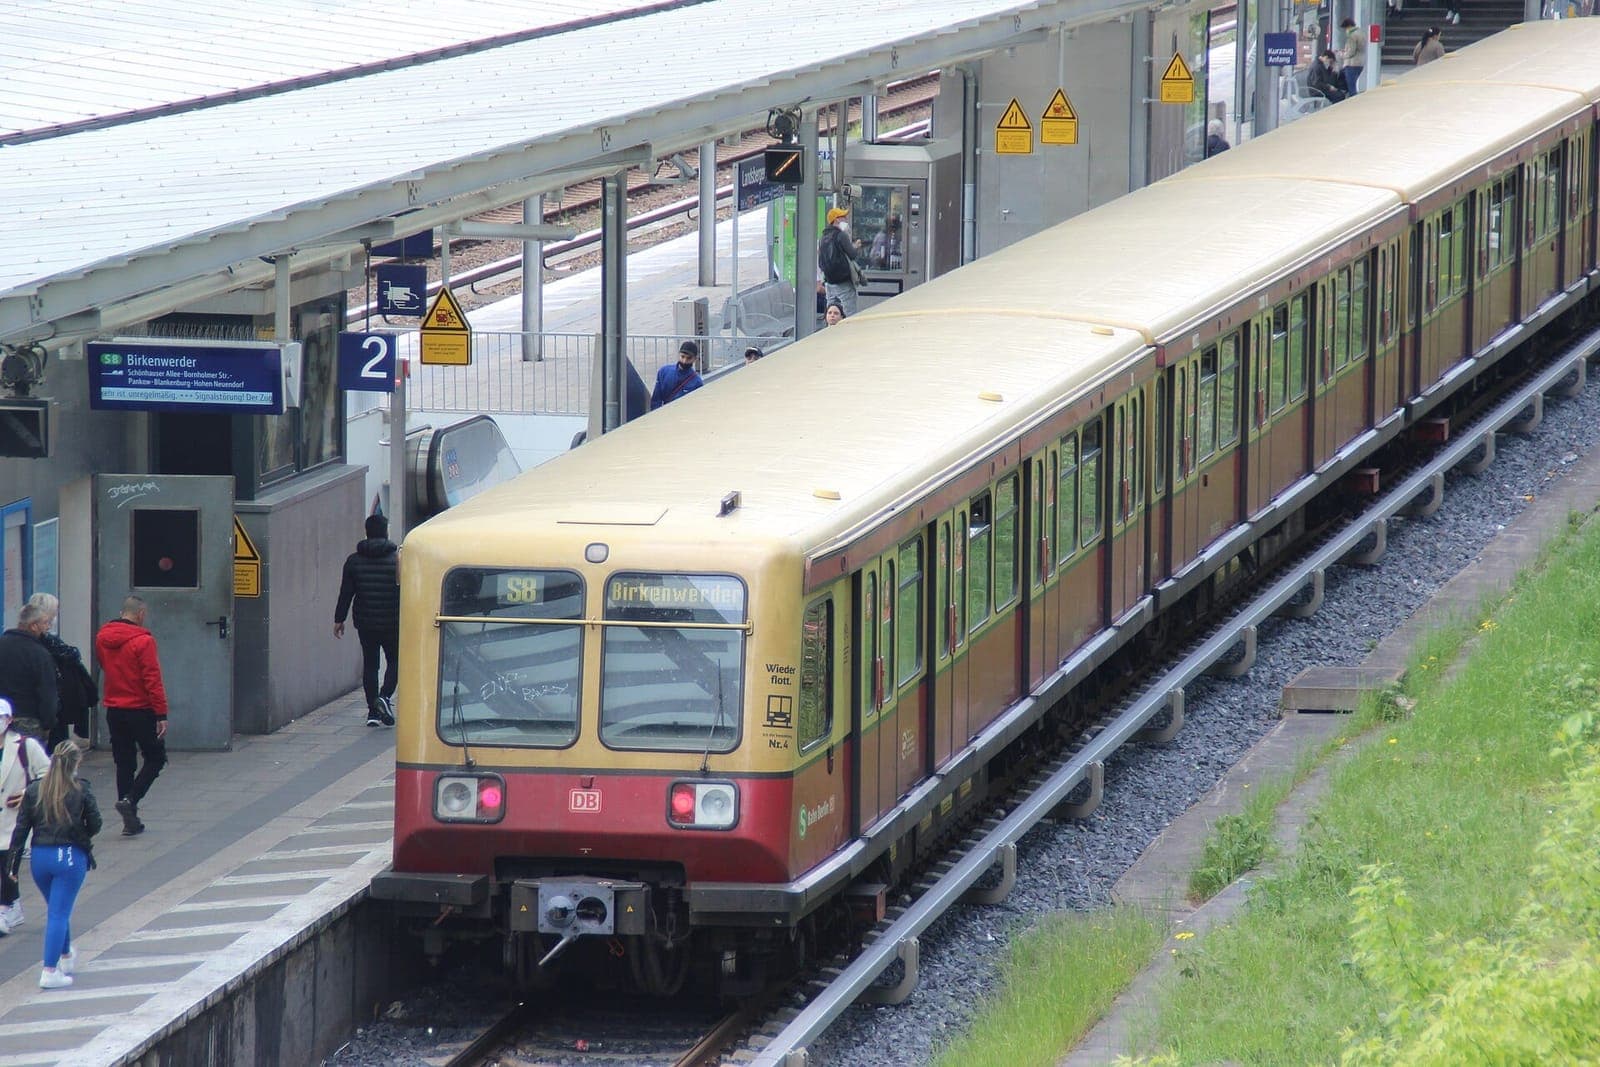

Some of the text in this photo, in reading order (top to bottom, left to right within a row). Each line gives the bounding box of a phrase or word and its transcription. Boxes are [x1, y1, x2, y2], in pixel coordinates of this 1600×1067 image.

[1268, 48, 1294, 56] Kurzzug
[1268, 56, 1291, 64] Anfang
[127, 353, 197, 368] Birkenwerder
[361, 335, 387, 378] 2
[127, 368, 165, 377] Schönhauser
[213, 380, 245, 388] Neuendorf
[246, 393, 258, 401] Der
[507, 576, 743, 603] S8 Birkenwerder
[765, 663, 797, 674] Wieder
[770, 675, 792, 685] flott.
[573, 793, 597, 809] DB
